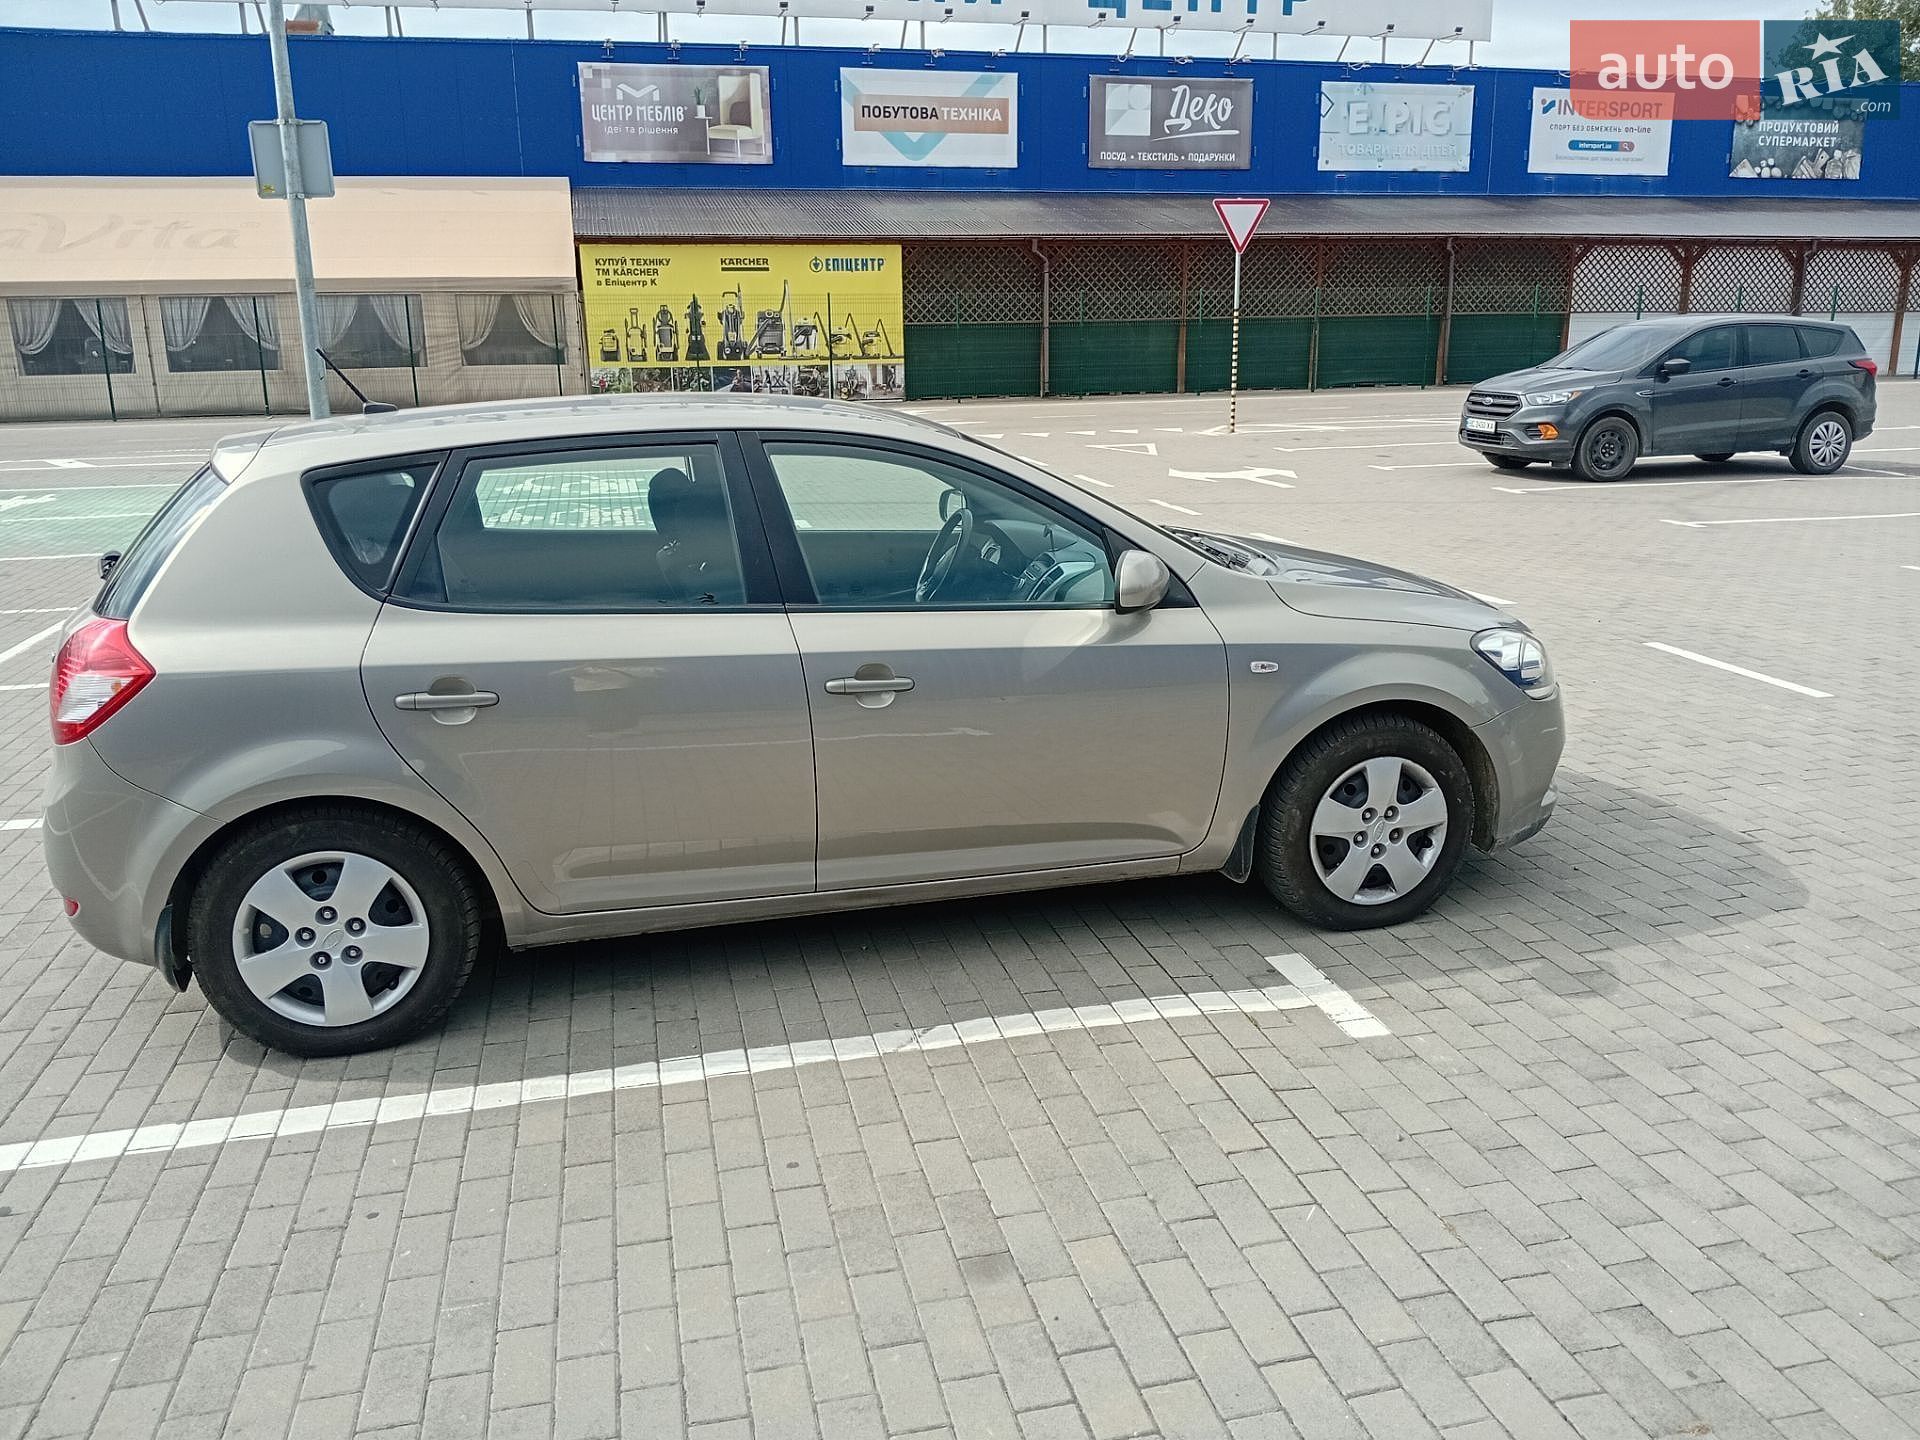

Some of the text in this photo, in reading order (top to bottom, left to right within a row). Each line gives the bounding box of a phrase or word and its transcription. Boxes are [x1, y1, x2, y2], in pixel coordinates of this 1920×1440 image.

[591, 103, 685, 122] ЦЕНТР МЕБЛІВ
[861, 104, 1003, 122] ПОБУТОВА ТЕХНІКА
[1163, 84, 1234, 134] Деко
[1557, 98, 1664, 119] INTERSPORT
[625, 126, 636, 134] та
[638, 126, 679, 136] рішення
[1758, 120, 1840, 134] ПРОДУКТОВИЙ
[1758, 135, 1837, 148] СУПЕРМАРКЕТ
[1100, 151, 1236, 163] ПОСУД ТЕКСТИЛЬ ПОДАРУНКИ
[594, 256, 671, 267] КУПУЙ ТЕХНІКУ
[825, 257, 885, 273] ЕПІЦЕНТР
[605, 278, 648, 288] Епіцентр
